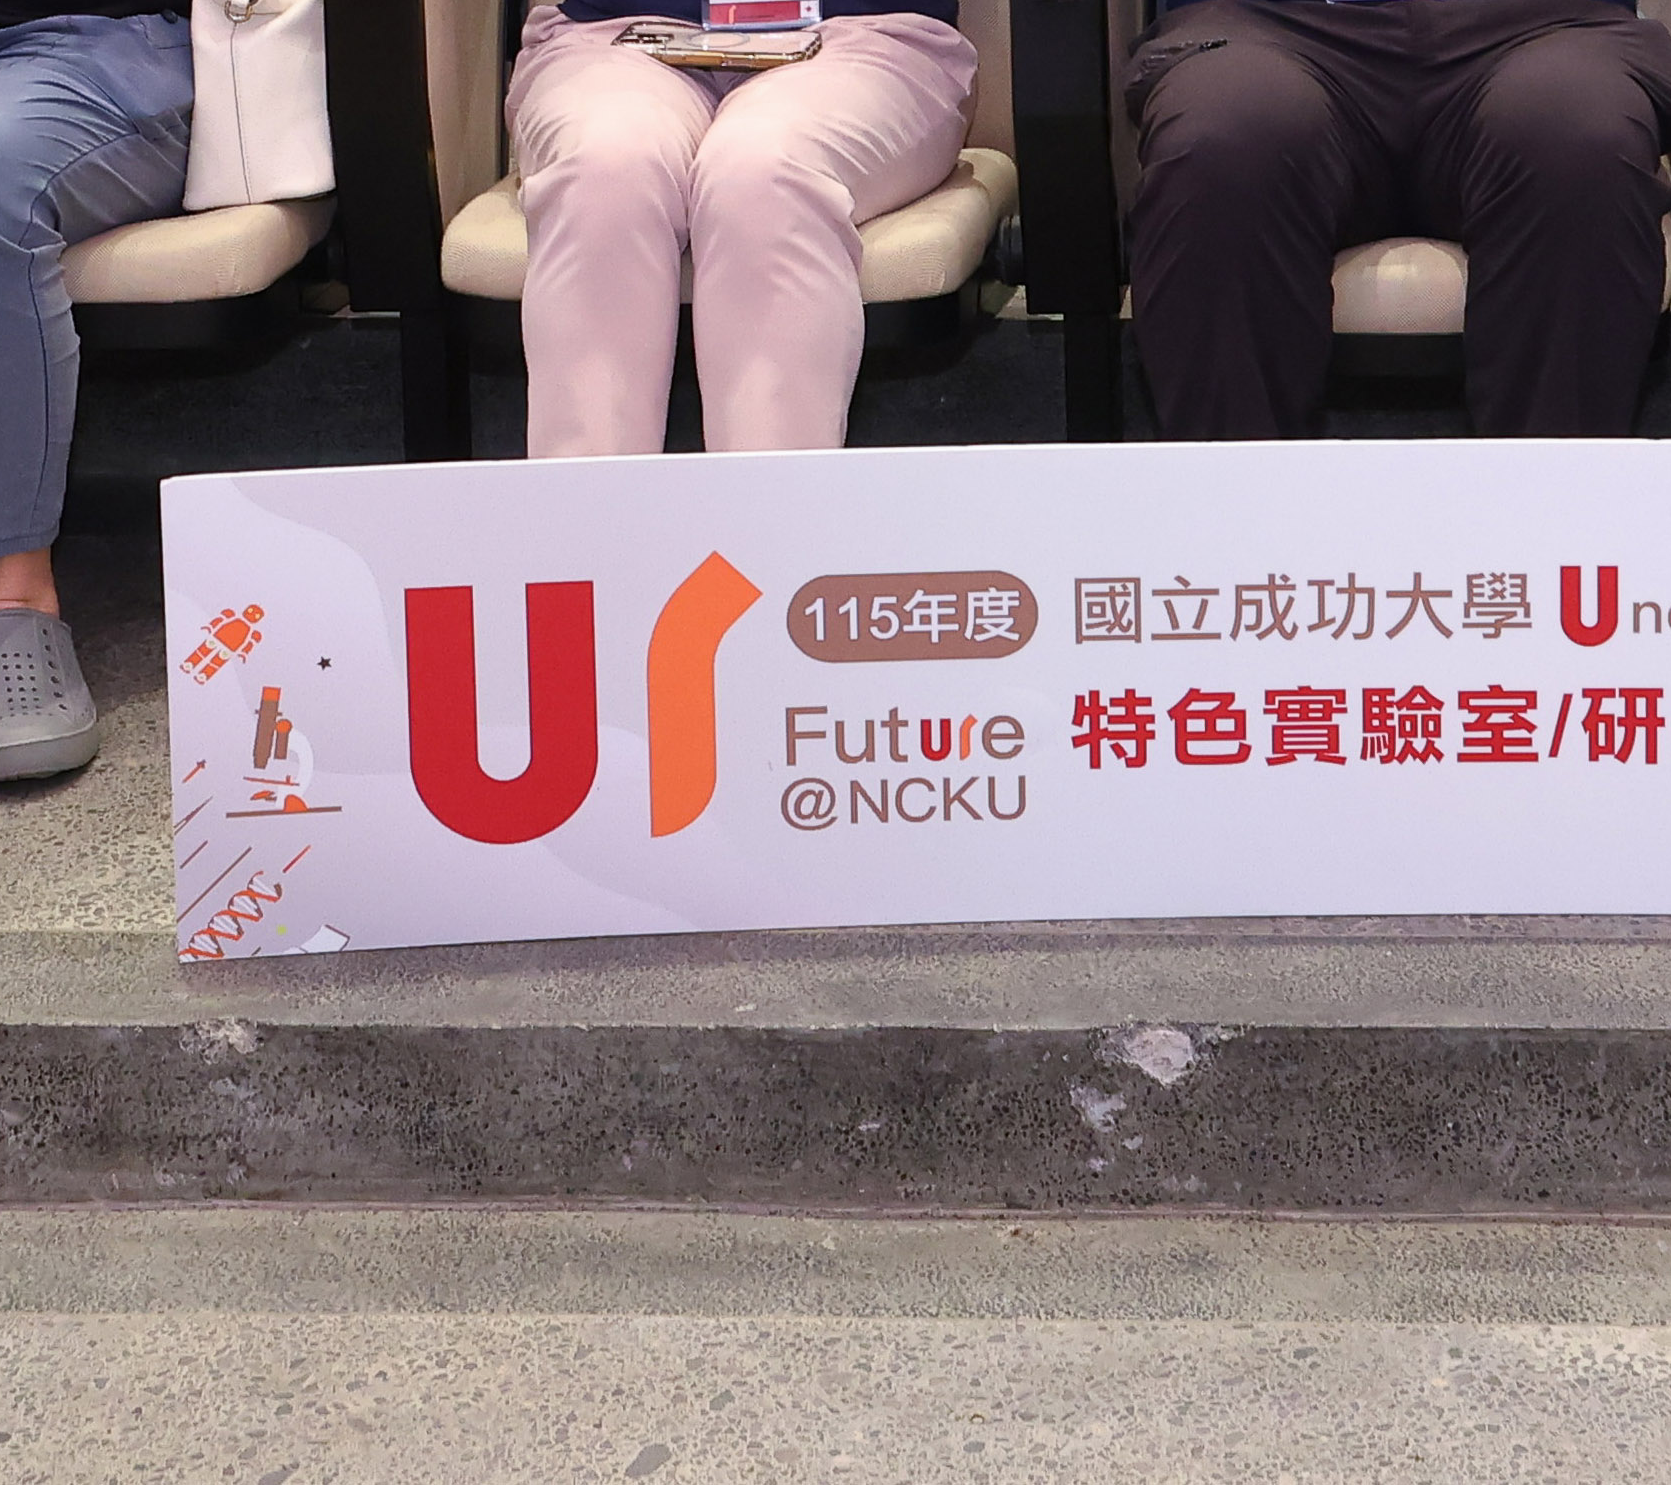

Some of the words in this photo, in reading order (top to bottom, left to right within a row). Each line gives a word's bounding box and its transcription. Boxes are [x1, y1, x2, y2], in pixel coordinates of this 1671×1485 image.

[803, 587, 1022, 643] 115年度
[1072, 571, 1533, 646] 國立成功大學
[785, 706, 1026, 766] Future
[780, 774, 1028, 831] @NCKU
